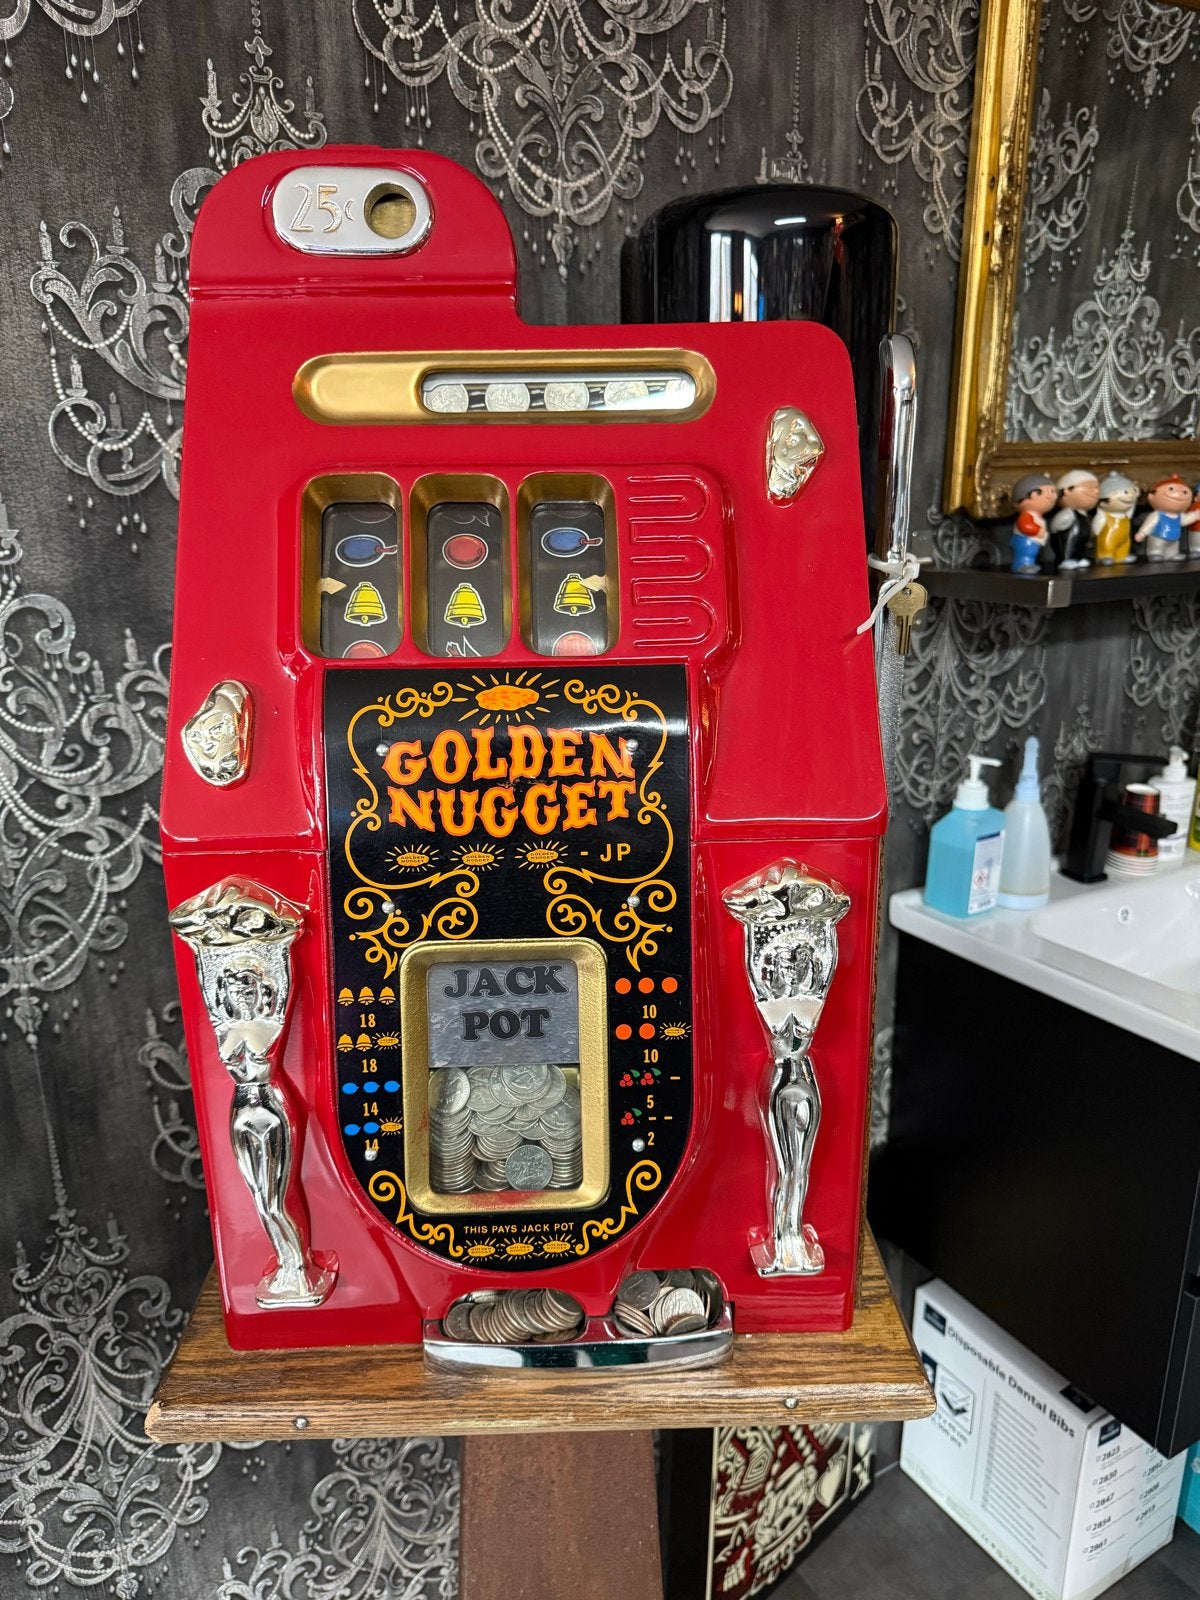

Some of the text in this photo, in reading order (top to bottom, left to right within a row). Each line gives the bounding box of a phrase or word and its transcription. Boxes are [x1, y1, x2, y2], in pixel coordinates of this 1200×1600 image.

[382, 725, 636, 785] GOLDEN
[387, 780, 636, 838] NUGGET
[600, 842, 631, 861] JP
[442, 965, 570, 998] JACK
[642, 1005, 657, 1019] 10
[360, 1013, 376, 1028] 18
[460, 1007, 551, 1041] POT
[643, 1049, 659, 1063] 10
[362, 1058, 378, 1073] 18
[363, 1102, 379, 1117] 14
[647, 1095, 655, 1109] 5
[647, 1132, 656, 1146] 2
[463, 1222, 575, 1234] THIS PAYS JACK POT
[947, 1327, 1006, 1380] Disposable
[1008, 1376, 1046, 1414] Dental
[1049, 1409, 1075, 1439] Bibs
